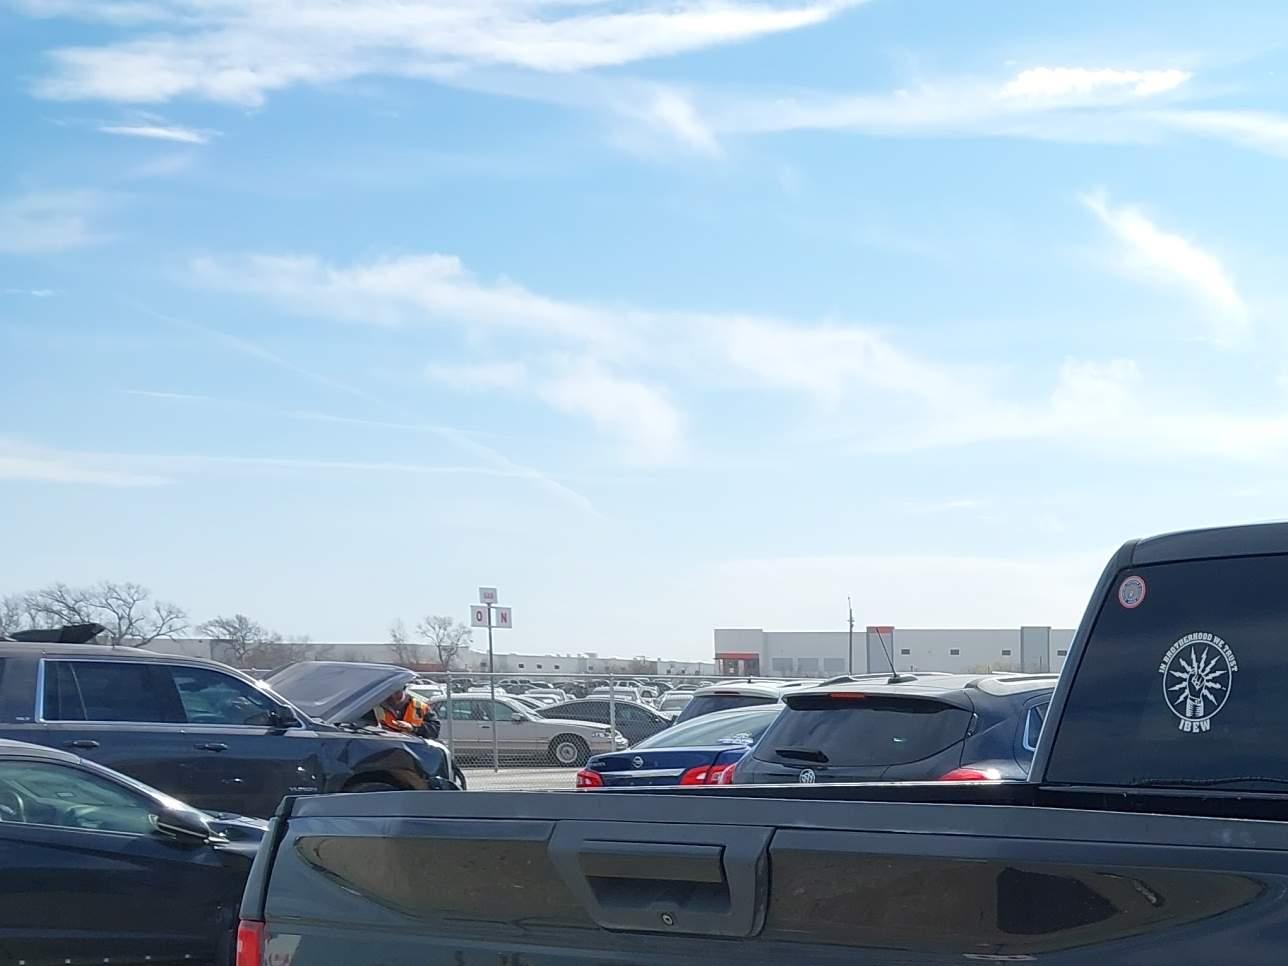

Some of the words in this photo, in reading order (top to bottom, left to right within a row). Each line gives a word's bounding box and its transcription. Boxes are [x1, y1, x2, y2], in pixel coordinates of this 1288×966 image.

[1158, 662, 1167, 673] IN
[1163, 632, 1213, 663] BROTHERHOOD
[1213, 635, 1225, 648] WE
[1222, 645, 1238, 672] TRUST
[1178, 719, 1210, 733] IBEW
